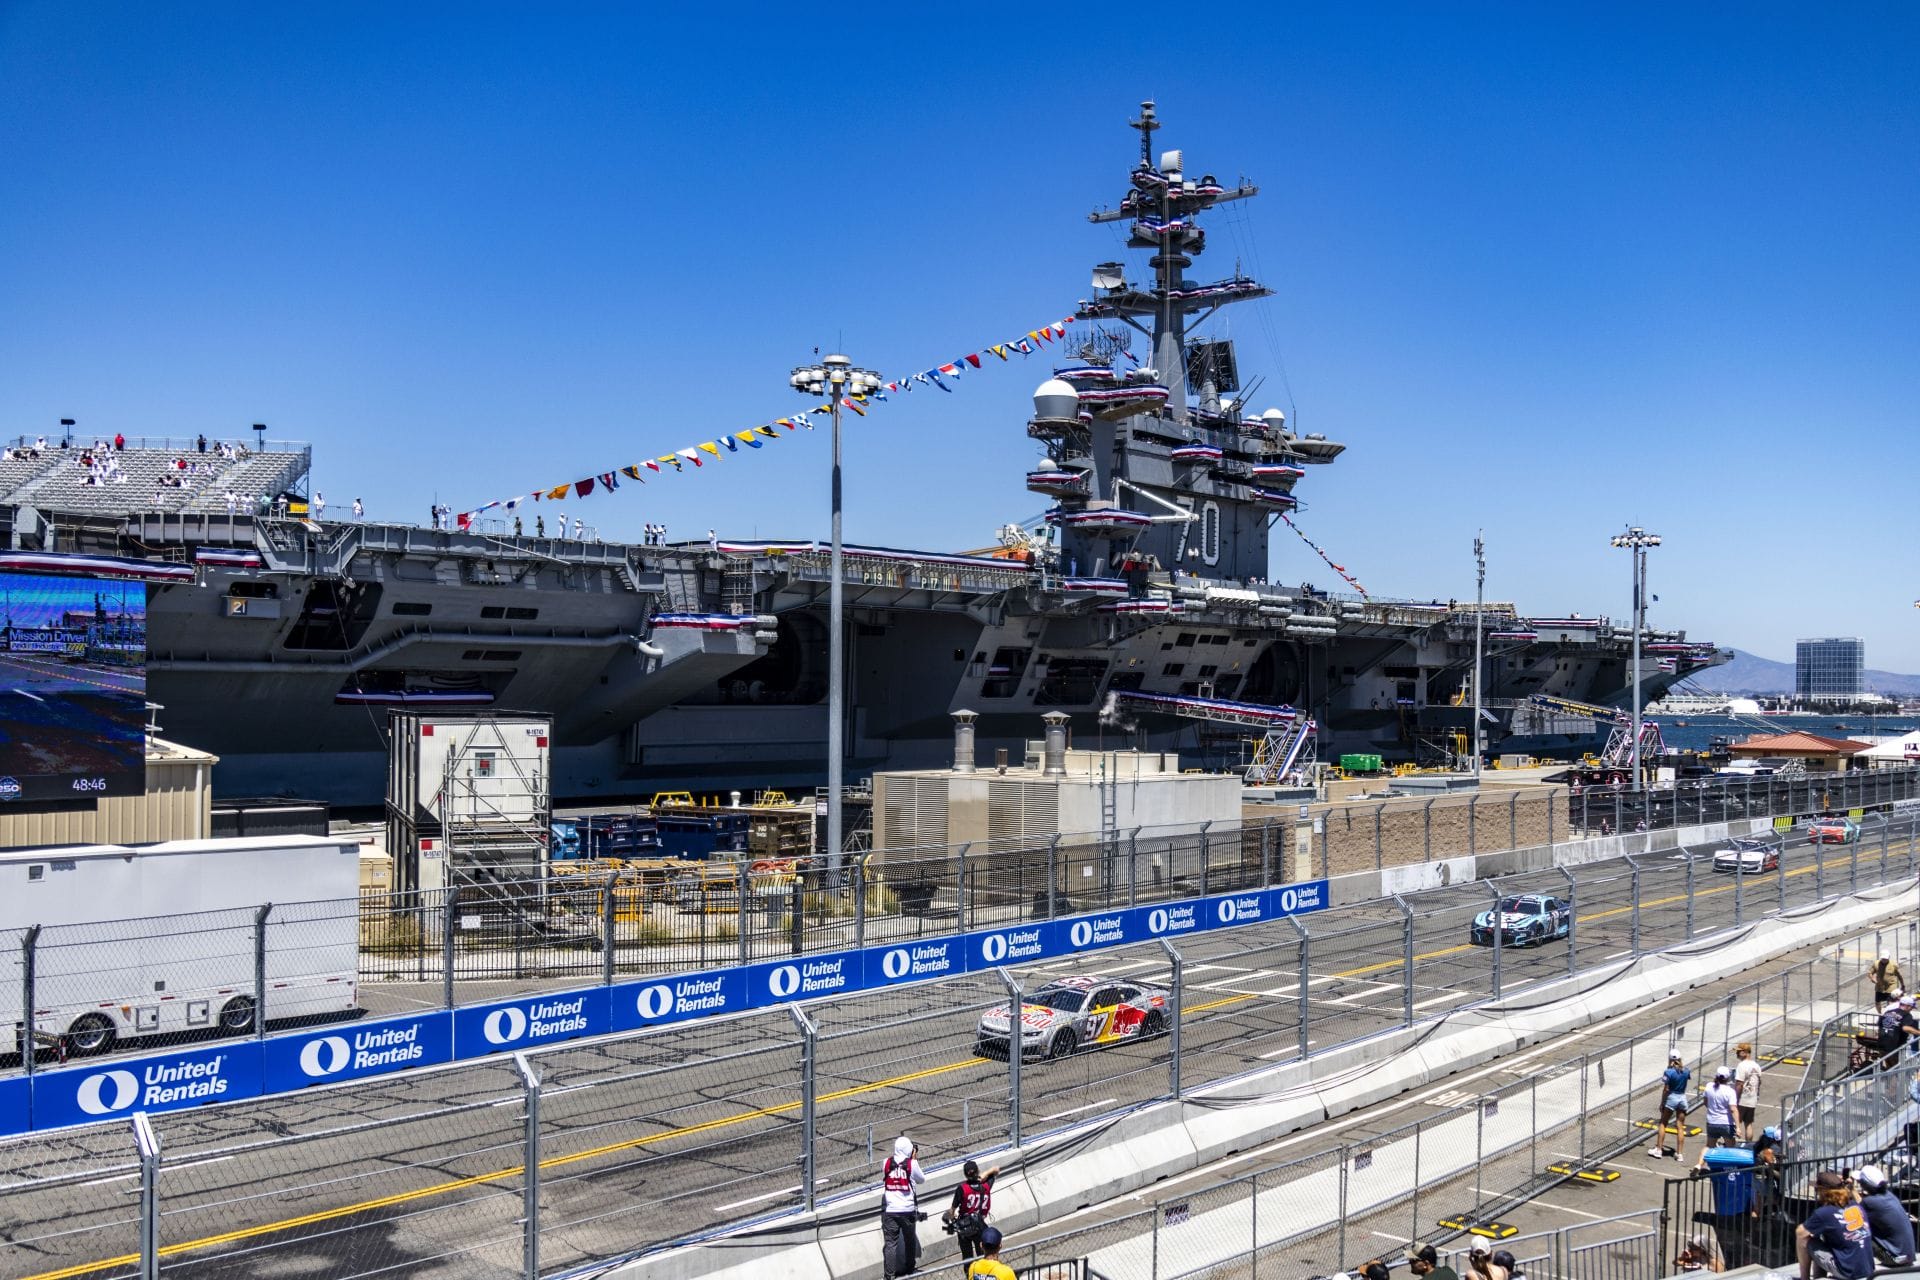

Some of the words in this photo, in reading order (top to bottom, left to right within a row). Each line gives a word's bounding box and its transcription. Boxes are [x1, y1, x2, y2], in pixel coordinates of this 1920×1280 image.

[1176, 495, 1220, 566] 70
[233, 601, 246, 614] 21
[9, 629, 52, 642] Mission
[54, 630, 88, 643] Driven
[72, 778, 106, 791] 48:46
[1298, 887, 1317, 898] United
[1237, 897, 1258, 909] United
[1298, 896, 1319, 908] Rentals
[1169, 906, 1193, 919] United
[1237, 908, 1260, 919] Rentals
[1094, 917, 1120, 931] United
[1169, 917, 1195, 930] Rentals
[1007, 930, 1039, 945] United
[1094, 929, 1123, 943] Rentals
[912, 944, 947, 960] United
[1007, 942, 1041, 958] Rentals
[803, 959, 842, 978] United
[912, 957, 950, 974] Rentals
[677, 977, 722, 997] United
[802, 974, 845, 994] Rentals
[530, 998, 583, 1020] United
[676, 993, 725, 1014] Rentals
[530, 1014, 587, 1038] Rentals
[1084, 1012, 1109, 1041] 97
[355, 1024, 417, 1050] United
[354, 1043, 423, 1069] Rentals
[145, 1056, 221, 1085] United
[144, 1076, 227, 1106] Rentals
[967, 1193, 989, 1210] 372
[1843, 1205, 1864, 1232] 9
